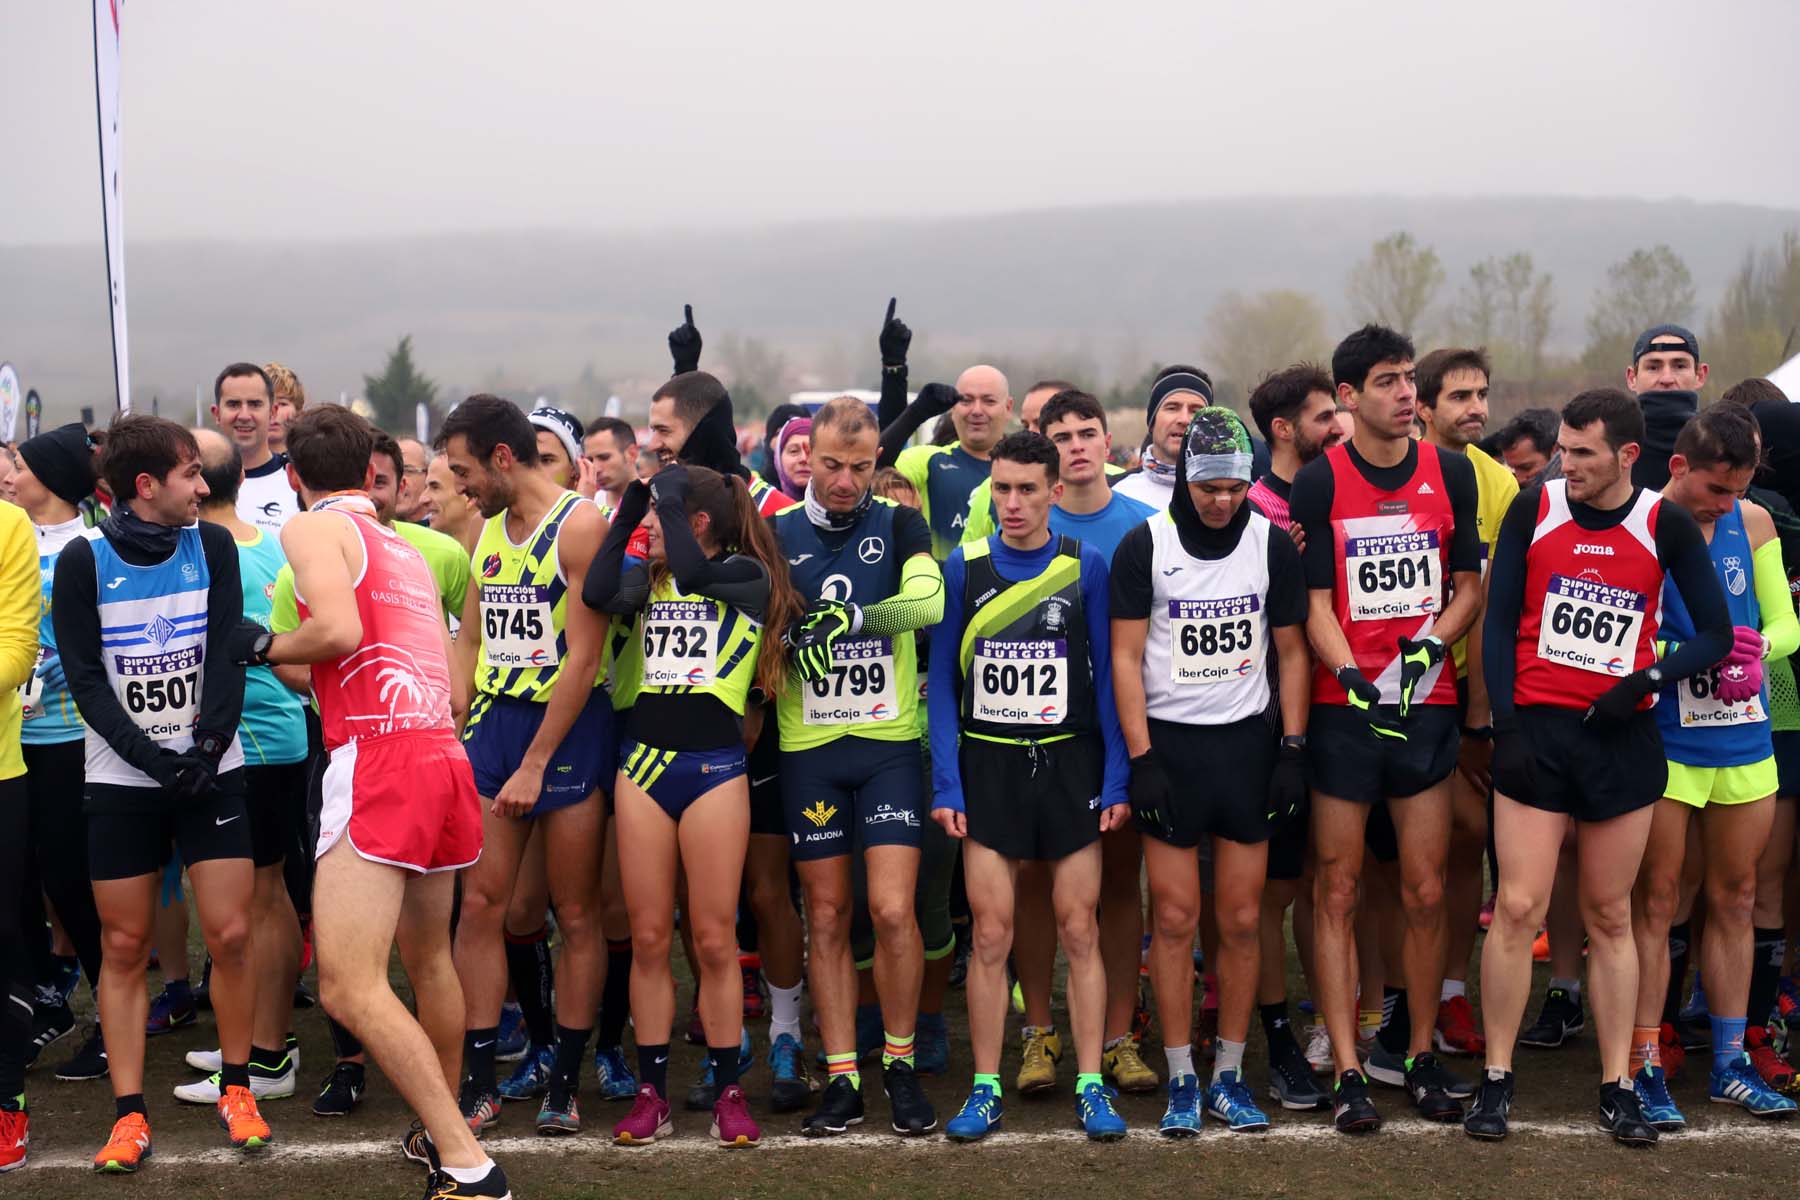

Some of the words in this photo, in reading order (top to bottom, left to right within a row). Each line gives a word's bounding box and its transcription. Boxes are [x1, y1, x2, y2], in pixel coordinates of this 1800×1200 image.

[1357, 532, 1428, 548] DIPUTACIÓN
[1357, 541, 1430, 556] BURGOS
[1358, 555, 1431, 594] 6501
[484, 585, 536, 594] DIPUTACIÓN
[1559, 577, 1639, 601] DIPUTACIÓN
[484, 594, 538, 603] BURGOS
[1179, 596, 1251, 610] DIPUTACIÓN
[1559, 586, 1636, 610] BURGOS
[651, 602, 707, 612] PUTACIÓN
[1179, 605, 1252, 618] BURGOS
[1358, 602, 1410, 615] iberCaja
[649, 611, 707, 620] URGOS
[485, 608, 544, 640] 6745
[1551, 601, 1634, 647] 6667
[644, 626, 708, 658] 6732
[984, 639, 1056, 650] DIPUTACIÓN
[1180, 619, 1252, 656] 6853
[832, 640, 882, 651] UTACIÓN
[123, 648, 195, 666] DIPUTACIÓN
[836, 648, 883, 660] RGOS
[983, 649, 1057, 659] BURGOS
[1545, 643, 1596, 665] berCaja
[123, 656, 196, 675] BURGOS
[1178, 666, 1229, 679] iberCaja
[645, 669, 678, 682] erCaja
[812, 662, 886, 698] 6799
[982, 663, 1057, 696] 6012
[126, 671, 198, 714] 6507
[810, 708, 860, 720] iberCaja
[979, 705, 1029, 720] iberCaja
[805, 830, 844, 842] AQUONA
